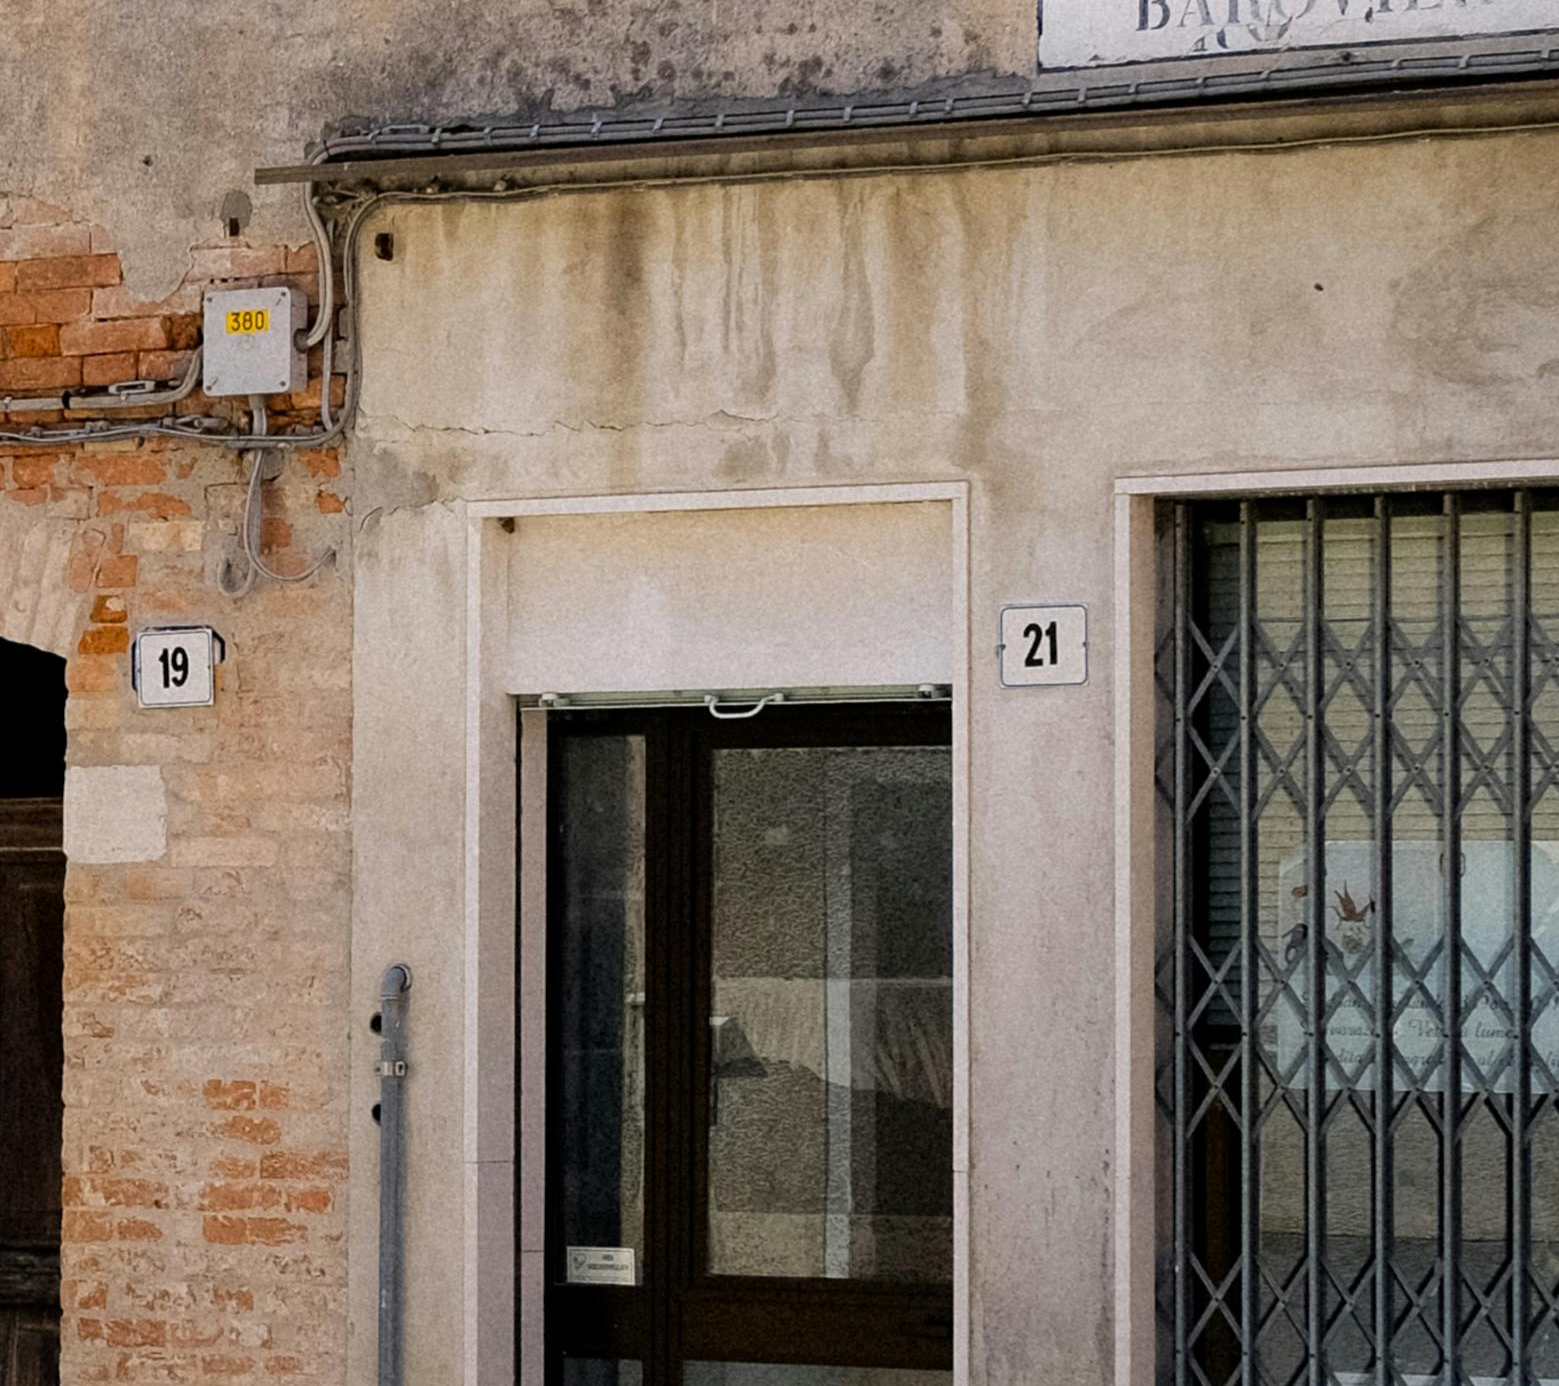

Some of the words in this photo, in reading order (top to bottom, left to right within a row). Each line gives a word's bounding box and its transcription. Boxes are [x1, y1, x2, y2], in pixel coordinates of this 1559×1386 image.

[231, 311, 265, 332] 380
[1023, 621, 1058, 667] 21
[158, 646, 189, 689] 19
